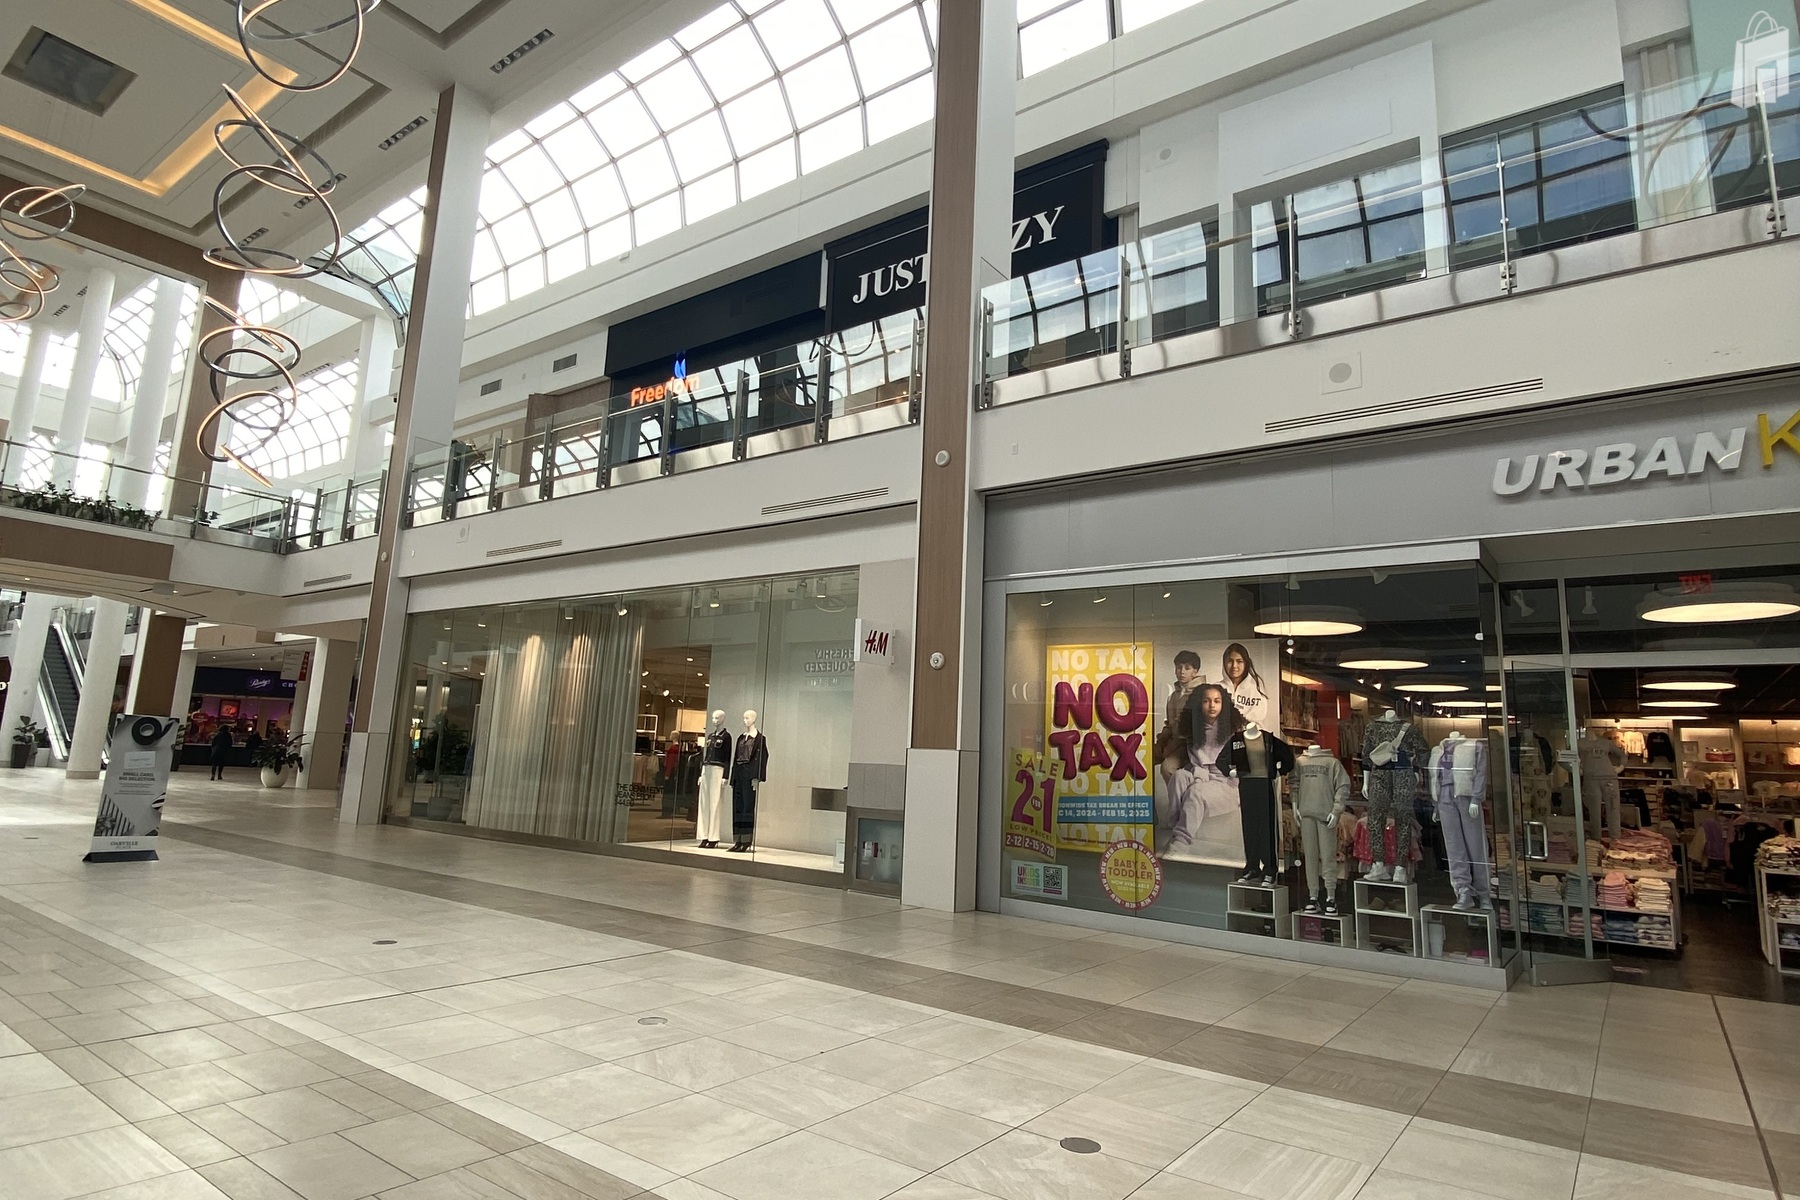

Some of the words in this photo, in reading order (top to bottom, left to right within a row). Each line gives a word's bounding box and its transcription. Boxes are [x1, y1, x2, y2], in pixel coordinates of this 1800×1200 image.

[852, 253, 928, 304] JUST
[1011, 205, 1065, 253] ZY
[630, 376, 700, 407] Freedom
[1492, 427, 1747, 495] URBAN
[864, 630, 889, 656] H&M
[1051, 649, 1089, 671] NO
[1095, 648, 1147, 671] TAX
[1053, 673, 1149, 734] NO
[1237, 695, 1261, 706] COAST
[1015, 754, 1058, 776] SALE
[1048, 730, 1147, 781] TAX
[1011, 769, 1034, 826] 2
[1040, 778, 1055, 833] 1
[1010, 824, 1028, 832] LOW
[1006, 834, 1022, 846] 2-12
[1025, 838, 1040, 851] 2-15
[1041, 844, 1055, 857] 2-20
[1108, 866, 1153, 880] TODDLER
[1113, 858, 1137, 869] BABY
[1140, 861, 1147, 870] &
